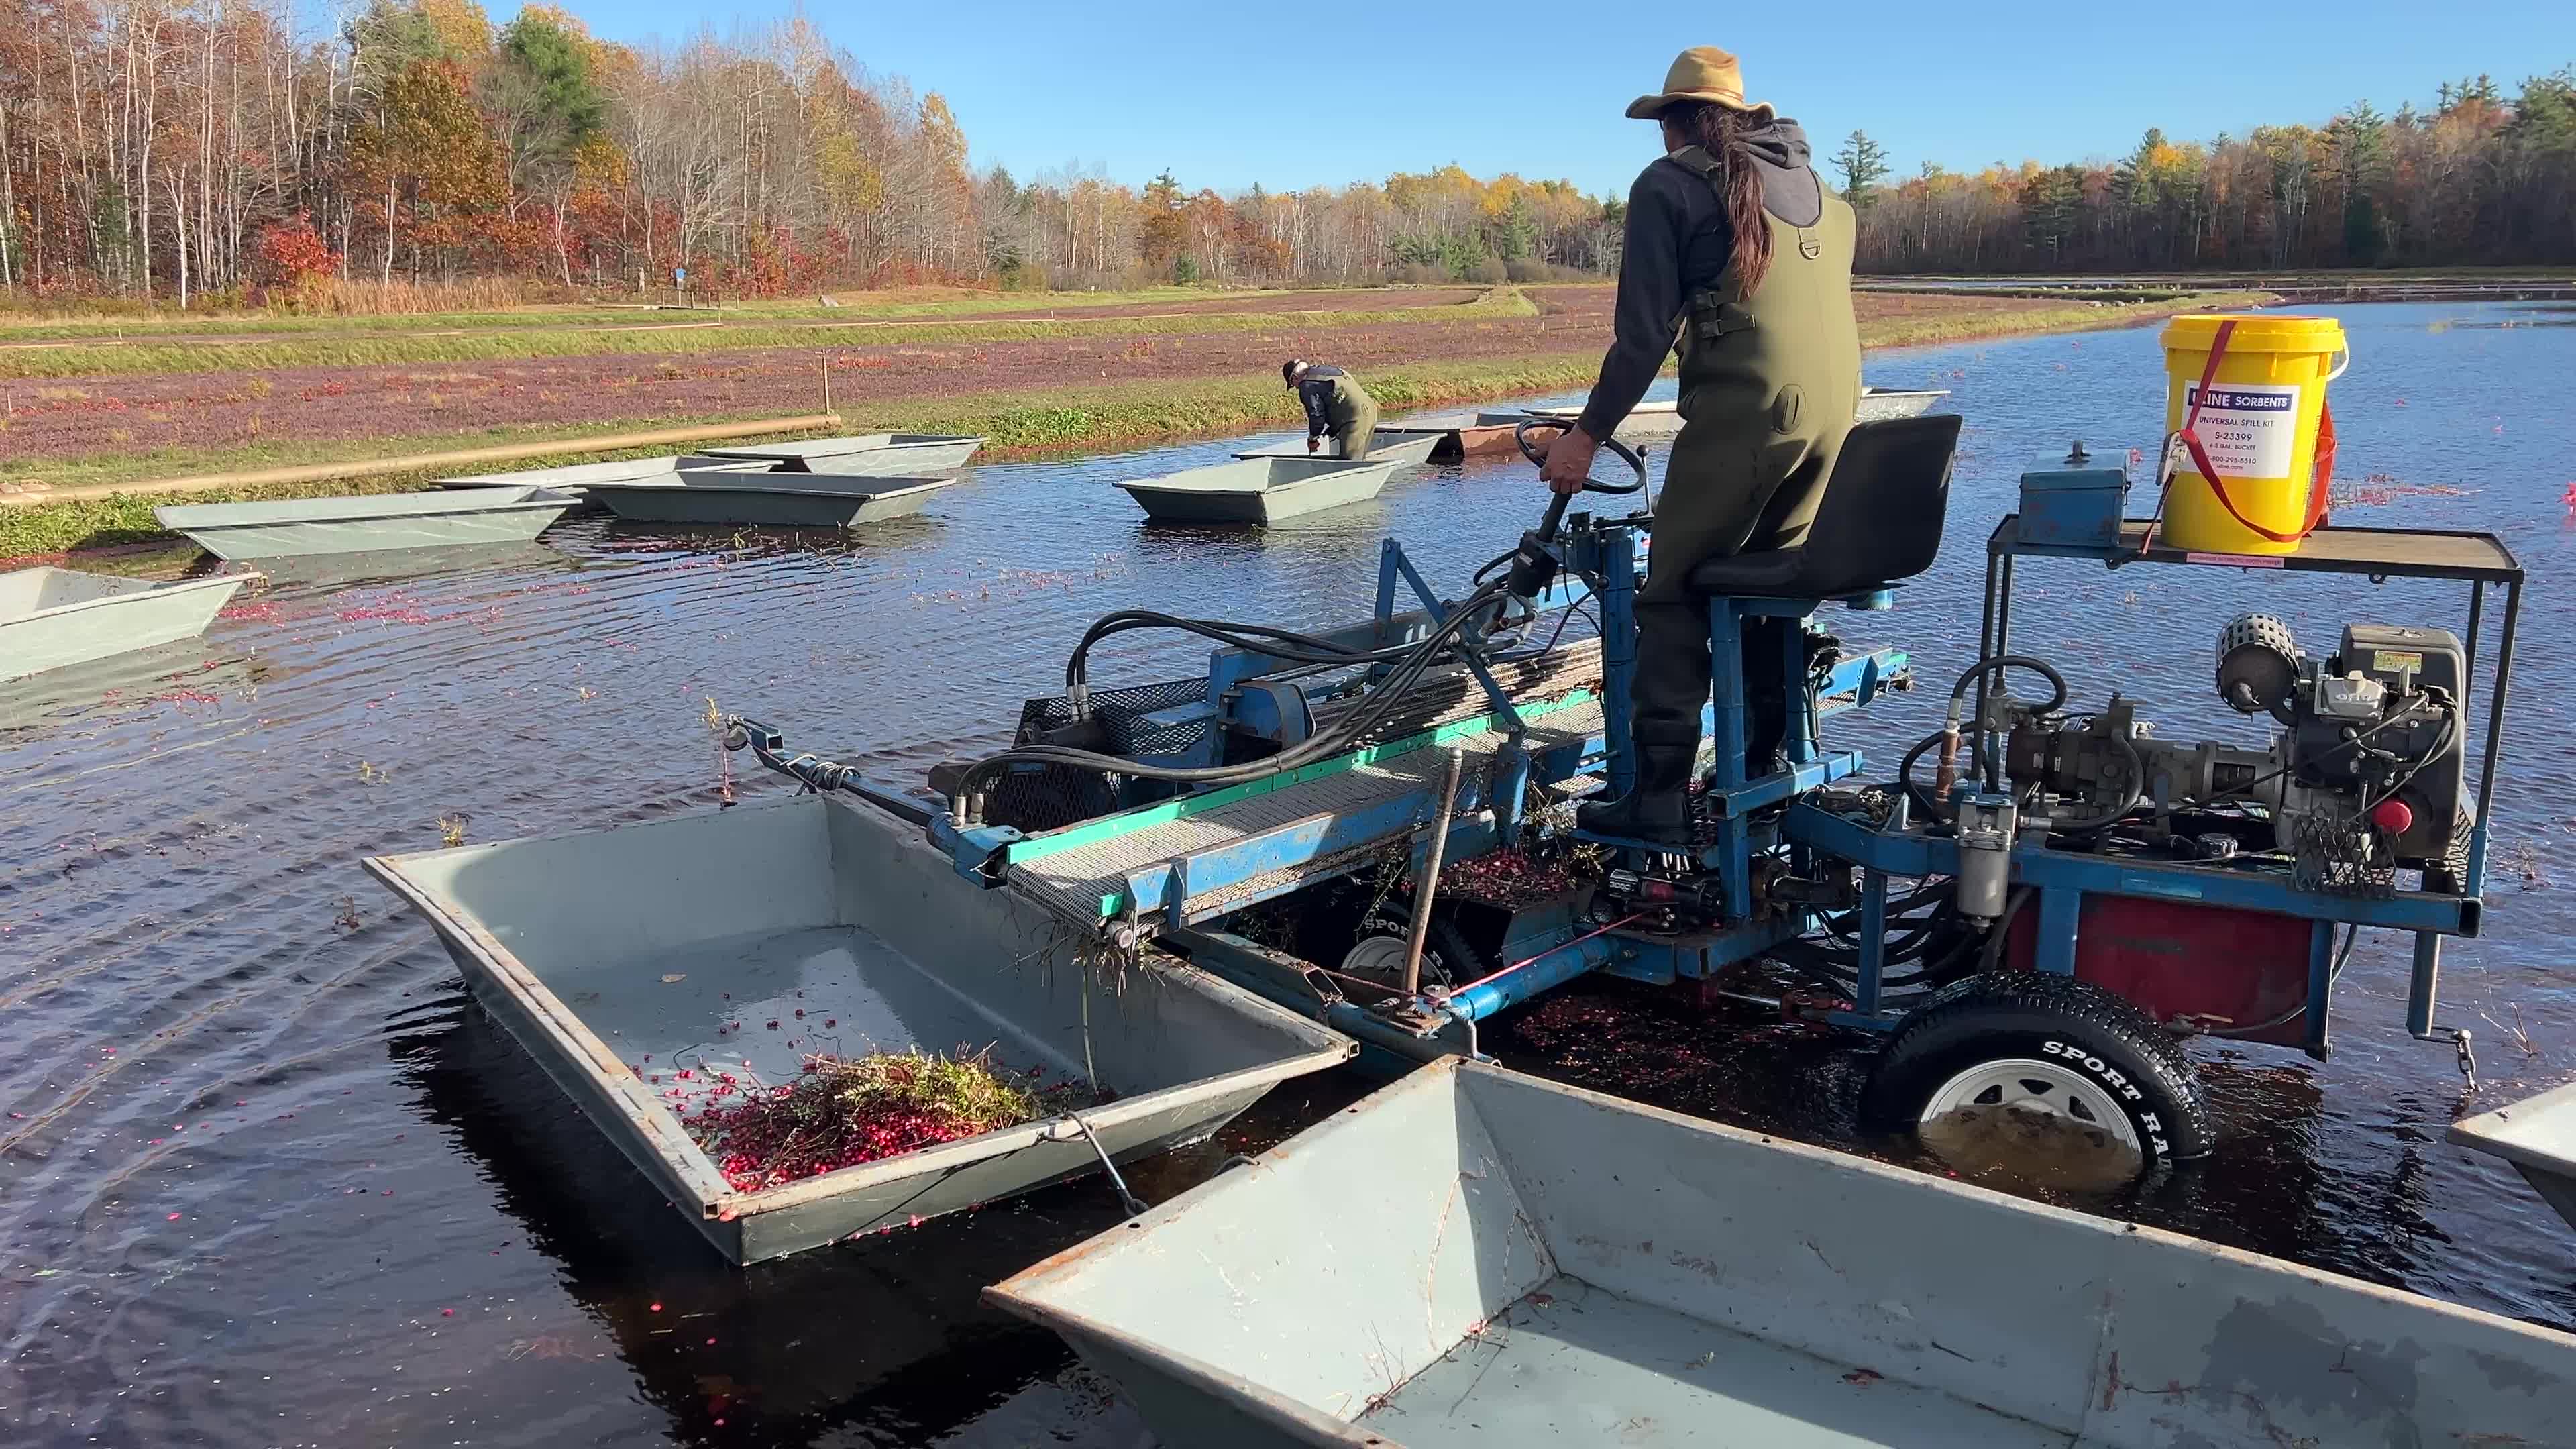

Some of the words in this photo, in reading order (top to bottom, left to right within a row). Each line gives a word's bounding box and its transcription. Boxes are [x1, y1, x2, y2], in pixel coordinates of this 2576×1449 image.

[2192, 391, 2230, 407] INE
[2235, 396, 2288, 408] SORBENTS
[2199, 416, 2238, 426] UNIVERSAL
[2241, 419, 2261, 427] SPILL
[2215, 432, 2253, 441] S-23399
[2206, 454, 2257, 464] -800-295-5510
[1364, 918, 1410, 937] SPOR
[2042, 1040, 2142, 1101] SPORT
